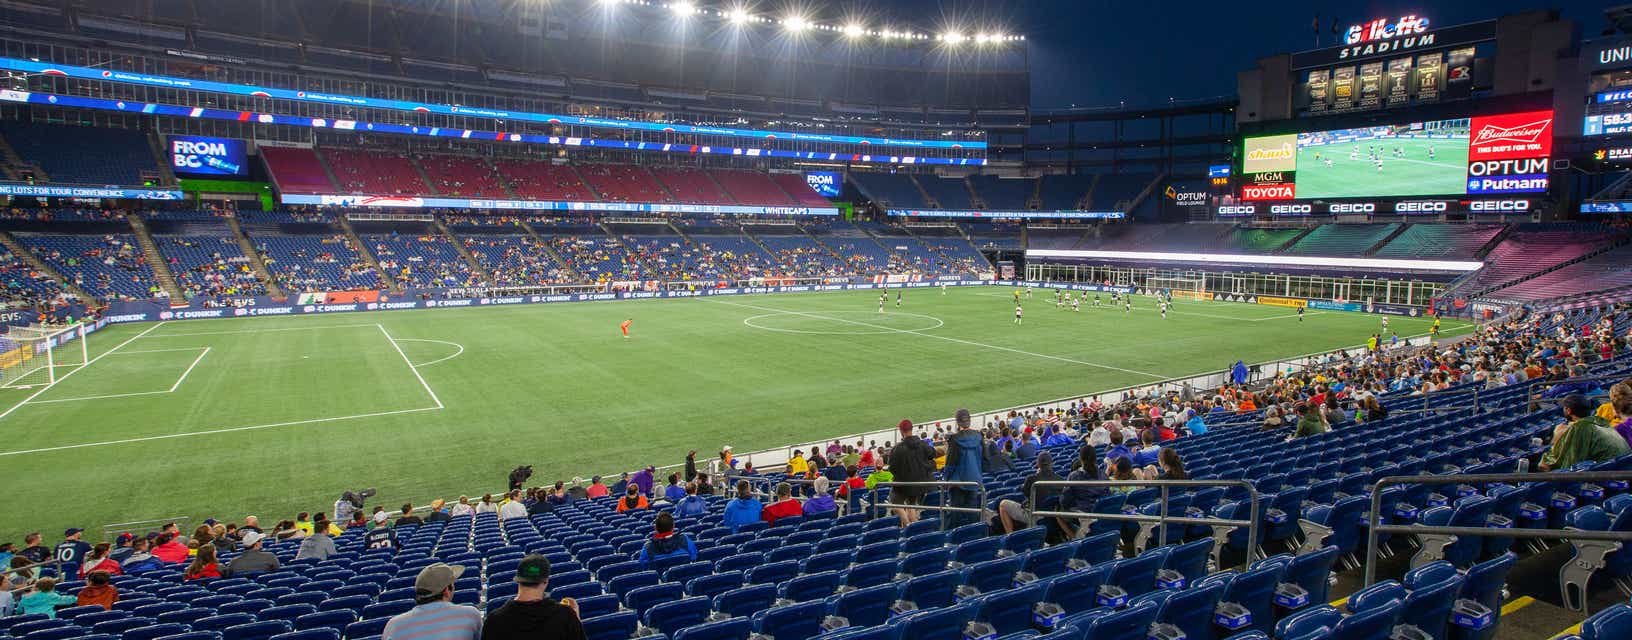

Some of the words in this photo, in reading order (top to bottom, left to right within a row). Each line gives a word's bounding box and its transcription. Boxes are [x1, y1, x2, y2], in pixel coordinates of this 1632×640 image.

[1344, 15, 1430, 44] Gillette
[1339, 34, 1436, 59] STADIUM
[1600, 45, 1632, 64] UNI
[1479, 127, 1542, 140] Budweiser
[173, 140, 228, 156] FROM
[1492, 145, 1512, 153] BUD'S
[1527, 143, 1543, 151] YOU.
[174, 154, 203, 168] BC
[1470, 158, 1549, 176] OPTUM
[807, 174, 834, 185] FROM
[1254, 171, 1284, 182] MGM
[1482, 178, 1547, 190] Putnam
[12, 186, 34, 195] LOTS
[34, 187, 50, 195] FOR
[51, 187, 73, 196] YOUR
[72, 188, 125, 198] CONVENIENCE
[1176, 192, 1207, 201] OPTUM
[1244, 186, 1294, 198] TOYOTA
[765, 206, 809, 215] WHITECAPS
[1218, 205, 1255, 214] GEICO
[1270, 204, 1312, 214] GEICO
[1329, 203, 1376, 214] GEICO
[1395, 201, 1447, 213] GEICO
[1470, 200, 1530, 211] GEICO
[184, 310, 223, 319] DUNKIN'
[257, 307, 293, 315] DUNKIN'
[57, 548, 75, 562] 10
